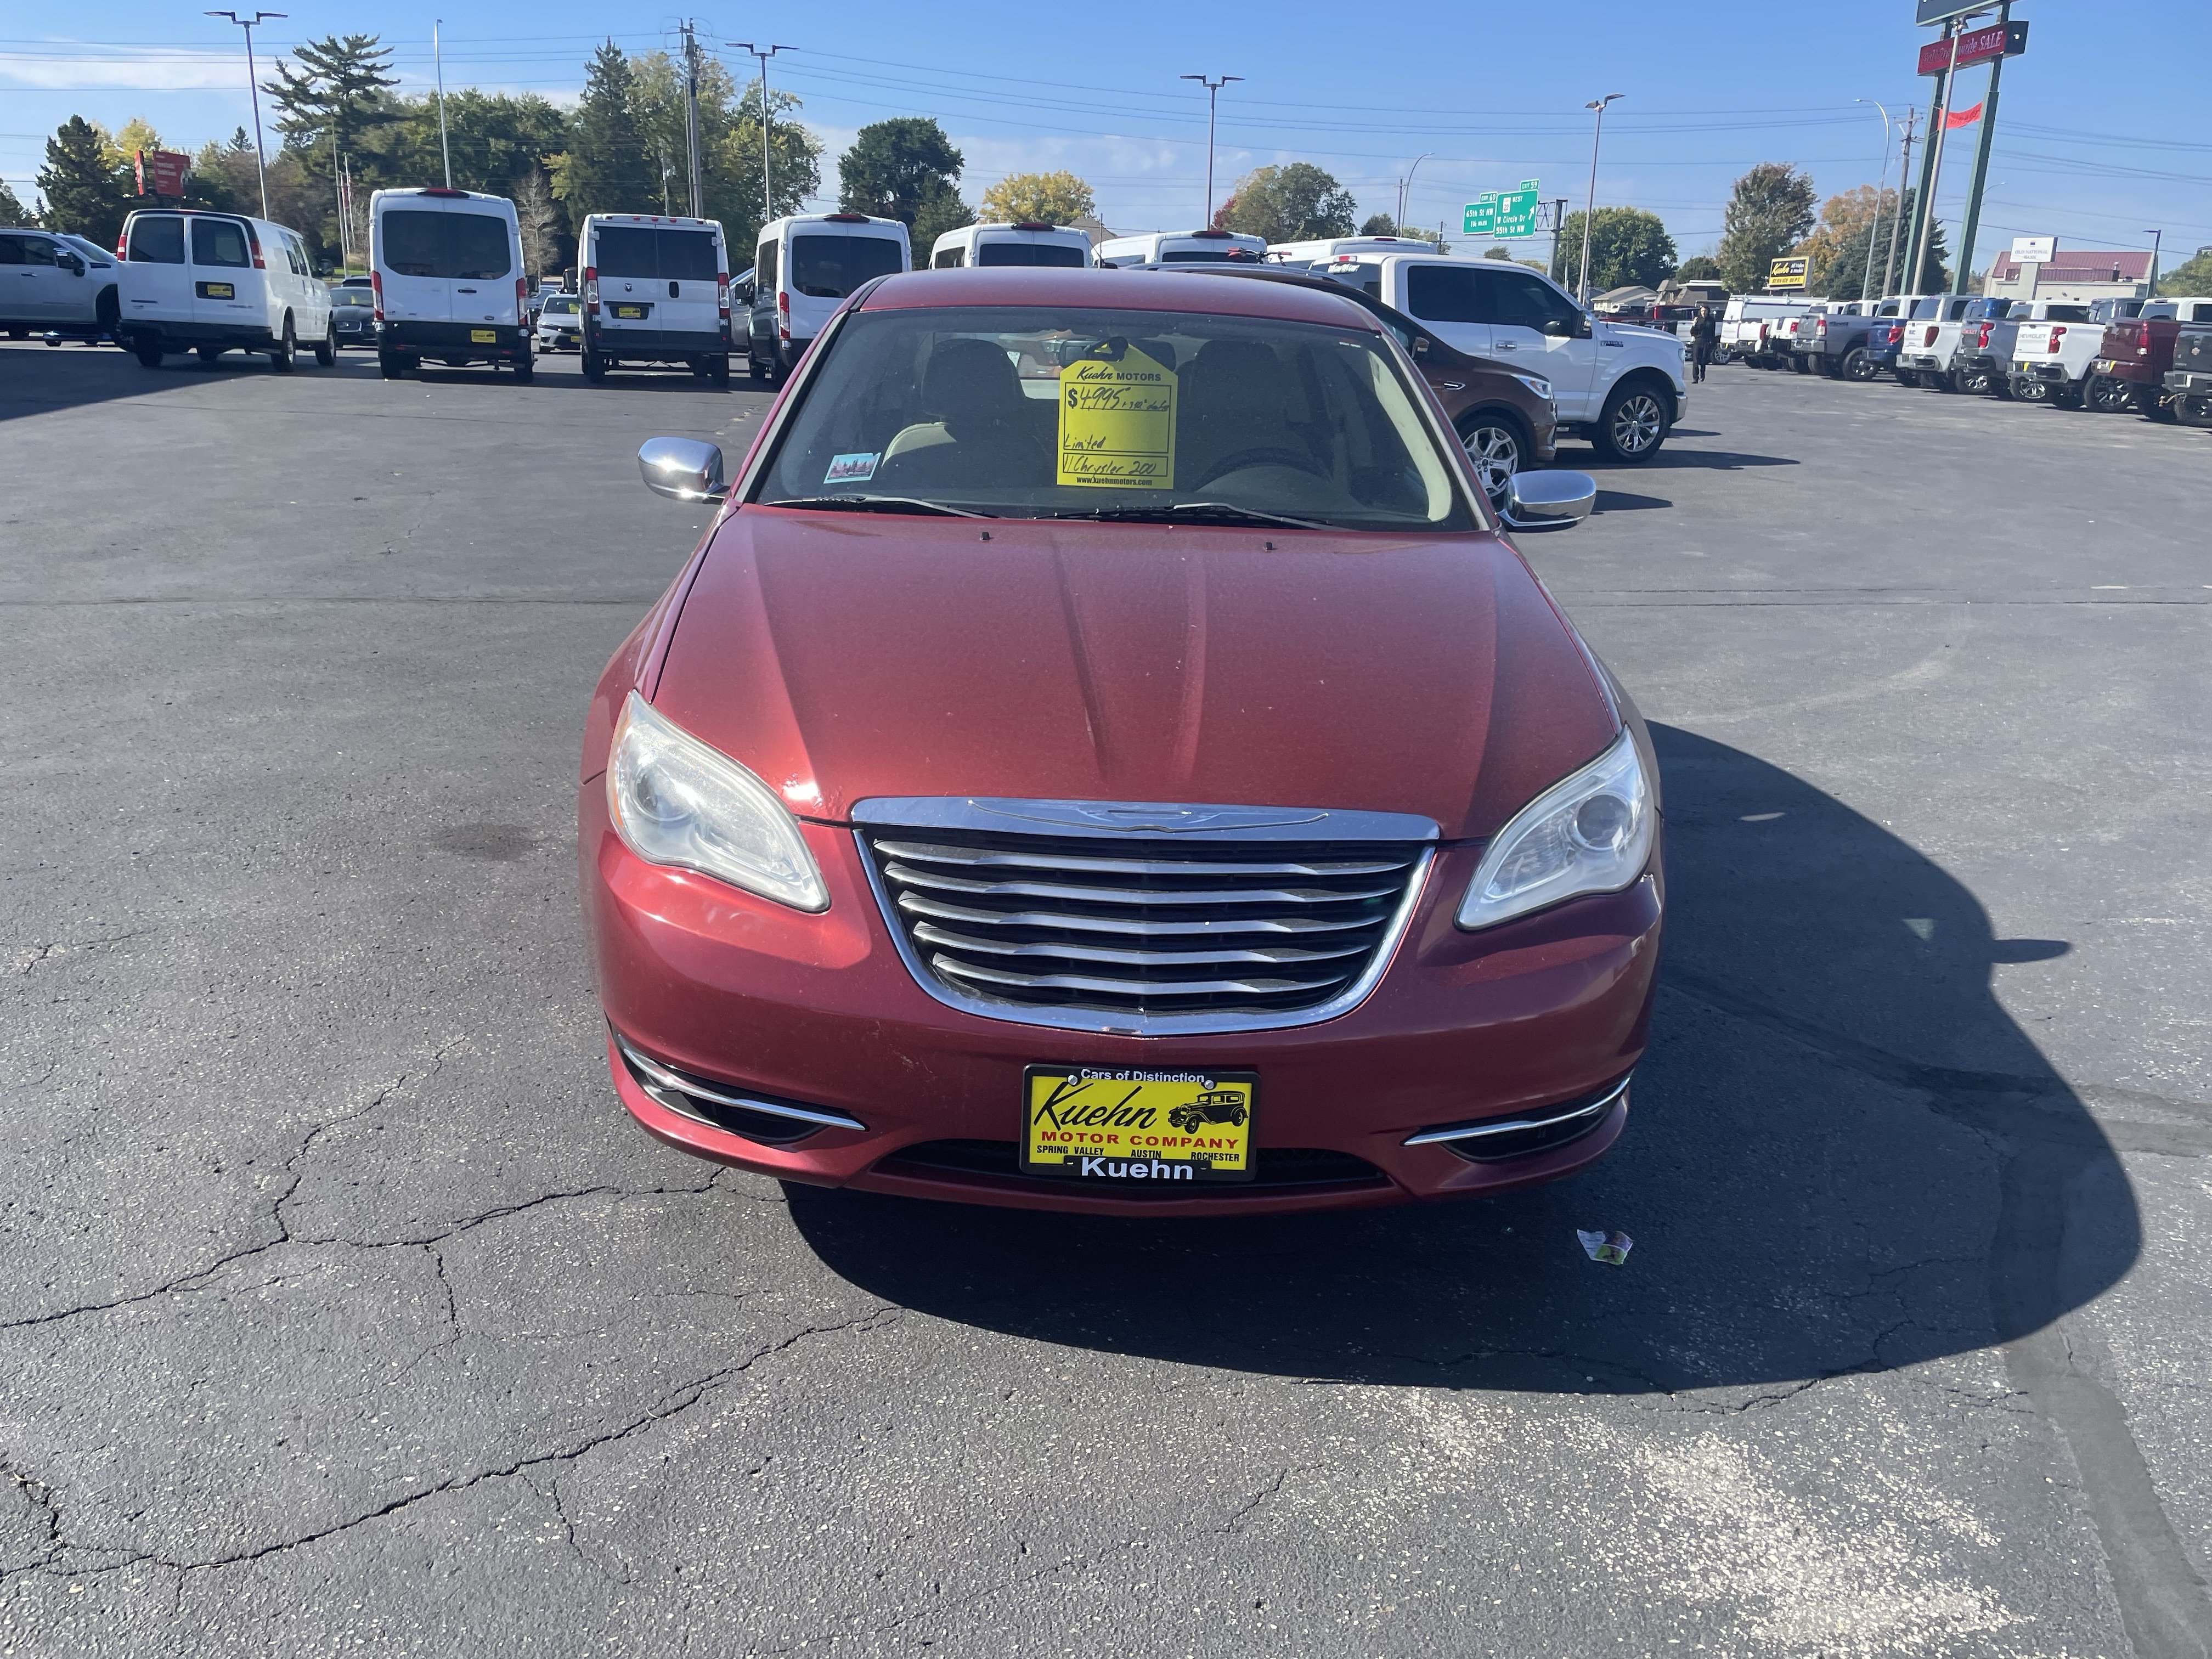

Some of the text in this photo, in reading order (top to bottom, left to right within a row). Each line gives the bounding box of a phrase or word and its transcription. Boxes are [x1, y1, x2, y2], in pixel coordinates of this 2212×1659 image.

[1979, 31, 2004, 51] SALE
[1466, 210, 1477, 218] 65th
[1503, 215, 1518, 224] Circle
[1519, 214, 1526, 222] Dr
[1496, 226, 1508, 235] 55th
[1076, 366, 1161, 381] Kuehn MOTORS
[1064, 433, 1106, 450] Limited
[1128, 460, 1157, 475] 200
[1076, 477, 1152, 486] www.kuehnmotors.com
[1081, 1068, 1205, 1083] Cars of Distinction
[1034, 1081, 1157, 1131] Kuehn
[1041, 1131, 1239, 1149] MOTOR COMPANY
[1036, 1145, 1240, 1162] SPRING VALLEY AUSTIN ROCHESTER
[1081, 1157, 1193, 1180] Kuehn
